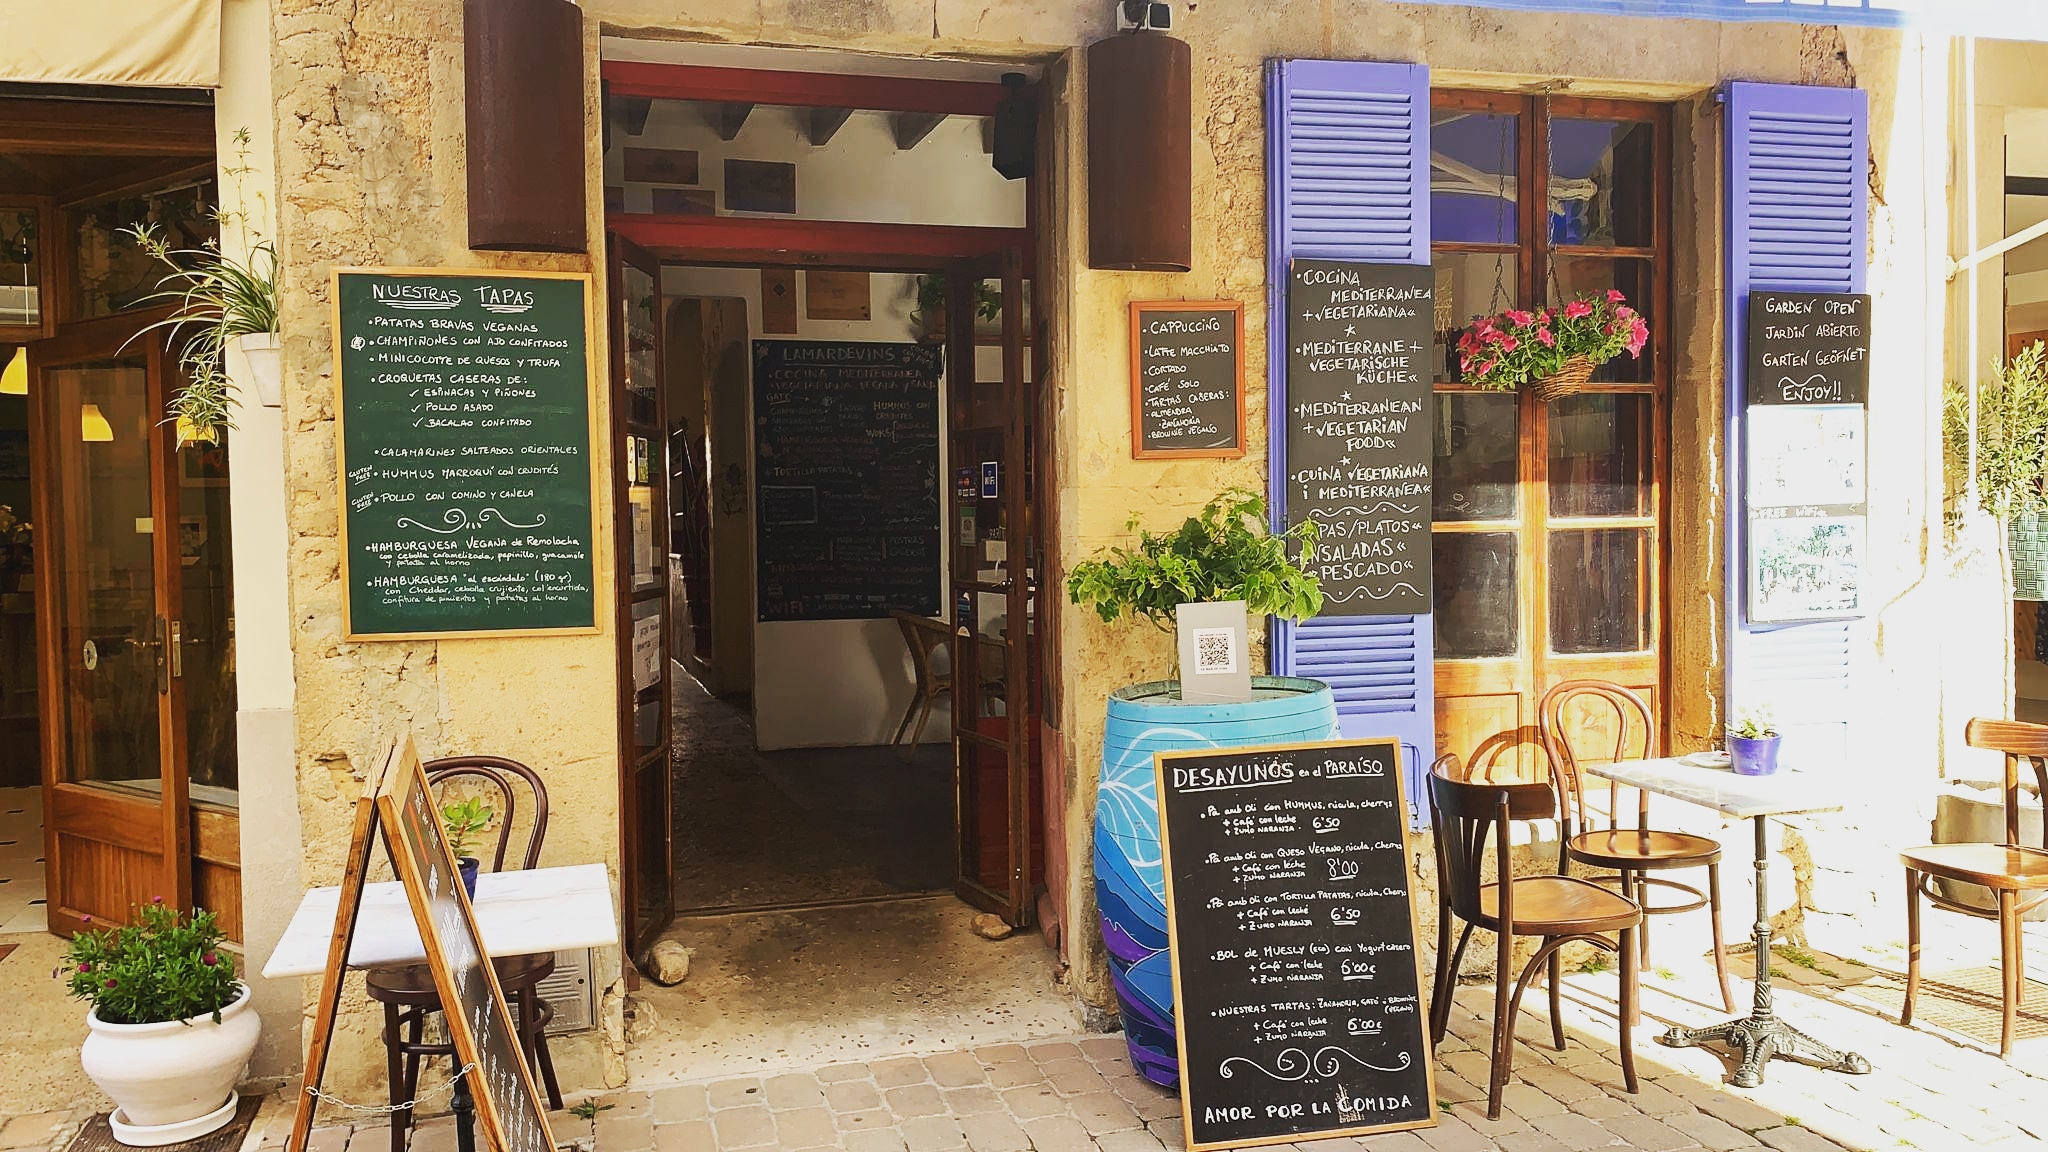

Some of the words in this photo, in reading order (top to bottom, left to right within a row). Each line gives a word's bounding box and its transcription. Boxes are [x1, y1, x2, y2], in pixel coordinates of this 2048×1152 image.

[1304, 269, 1360, 286] COCINA
[373, 284, 461, 304] NUESTRAS
[473, 286, 534, 306] TAPAS
[1331, 285, 1431, 303] MEDITERRANEA
[1766, 298, 1817, 313] GARDEN
[1824, 299, 1861, 314] OPEN
[375, 316, 424, 329] PATATAS
[430, 320, 474, 332] BRAVAS
[483, 323, 537, 332] VEGANAS
[1150, 318, 1220, 334] CAPPUCCINO
[1766, 324, 1810, 339] JARDIN
[1816, 323, 1860, 337] ABIERTO
[377, 334, 457, 346] CHAMPIÑONES
[463, 337, 481, 345] CON
[488, 338, 505, 346] AJO
[509, 338, 568, 348] CONFITADOS
[1303, 339, 1405, 357] MEDITERRANE
[784, 347, 895, 361] LAMARDEVINS
[1149, 345, 1176, 357] LATTE
[1181, 344, 1229, 356] MACCHIATO
[378, 354, 453, 365] MINICOCOTTE
[458, 356, 470, 365] DE
[475, 357, 510, 366] QUESOS
[517, 358, 525, 367] Y
[527, 358, 560, 367] TRUFA
[1310, 356, 1409, 372] VEGETARISCHE
[1763, 350, 1810, 366] GARTEN
[1148, 365, 1186, 376] CORTADO
[378, 374, 442, 384] CROQUETAS
[450, 375, 501, 384] CASERAS
[508, 376, 528, 384] DE:
[1149, 378, 1171, 393] CAFÉ
[1178, 380, 1200, 389] SOLO
[424, 388, 474, 397] ESPINACAS
[495, 388, 536, 398] PIÑONES
[1783, 380, 1841, 401] ENJOY!!
[426, 403, 457, 411] POLLO
[464, 403, 493, 411] ASADO
[1148, 396, 1181, 407] TARTAS
[1301, 397, 1422, 418] MEDITERRANEAN
[1151, 407, 1192, 417] ALMENDRA
[425, 419, 473, 427] BACALAO
[482, 419, 531, 427] CONFITADO
[1152, 428, 1183, 439] BROWNIE
[1188, 424, 1217, 435] VEGANO
[381, 448, 455, 457] CALAMARINES
[461, 446, 513, 455] SALTEADOS
[521, 444, 577, 455] ORIENTALES
[383, 469, 434, 479] HUMMUS
[442, 466, 494, 477] MARROQUÍ
[498, 467, 514, 476] CON
[1298, 464, 1341, 483] CUINA
[1348, 463, 1428, 481] VEGETARIANA
[381, 492, 414, 502] POLLO
[426, 492, 444, 500] CON
[452, 490, 486, 500] COMINO
[500, 489, 533, 498] CANELA
[372, 542, 457, 551] HAMBURGUESA
[466, 536, 506, 547] VEGANA
[512, 538, 523, 546] de
[527, 537, 579, 546] Remolacha
[375, 575, 457, 587] HAMBURGUESA
[409, 586, 450, 595] Cheddar,
[1174, 763, 1294, 788] DESAYUNOS
[1299, 769, 1309, 777] en
[1313, 766, 1320, 777] el
[1325, 757, 1383, 774] PARAÍSO
[1264, 802, 1281, 811] con
[1275, 815, 1296, 823] leche
[1277, 848, 1305, 857] QUESO
[1217, 950, 1238, 961] BOL
[1245, 949, 1258, 958] de
[1264, 946, 1305, 956] MUESLY
[1304, 960, 1323, 969] leche
[1219, 1005, 1266, 1017] NUESTRAS
[1271, 1002, 1315, 1011] TARTAS:
[1291, 1019, 1304, 1027] con
[1205, 1106, 1255, 1124] AMOR
[1266, 1104, 1304, 1118] POR
[1312, 1100, 1331, 1114] LA
[1338, 1095, 1412, 1112] COMIDA
